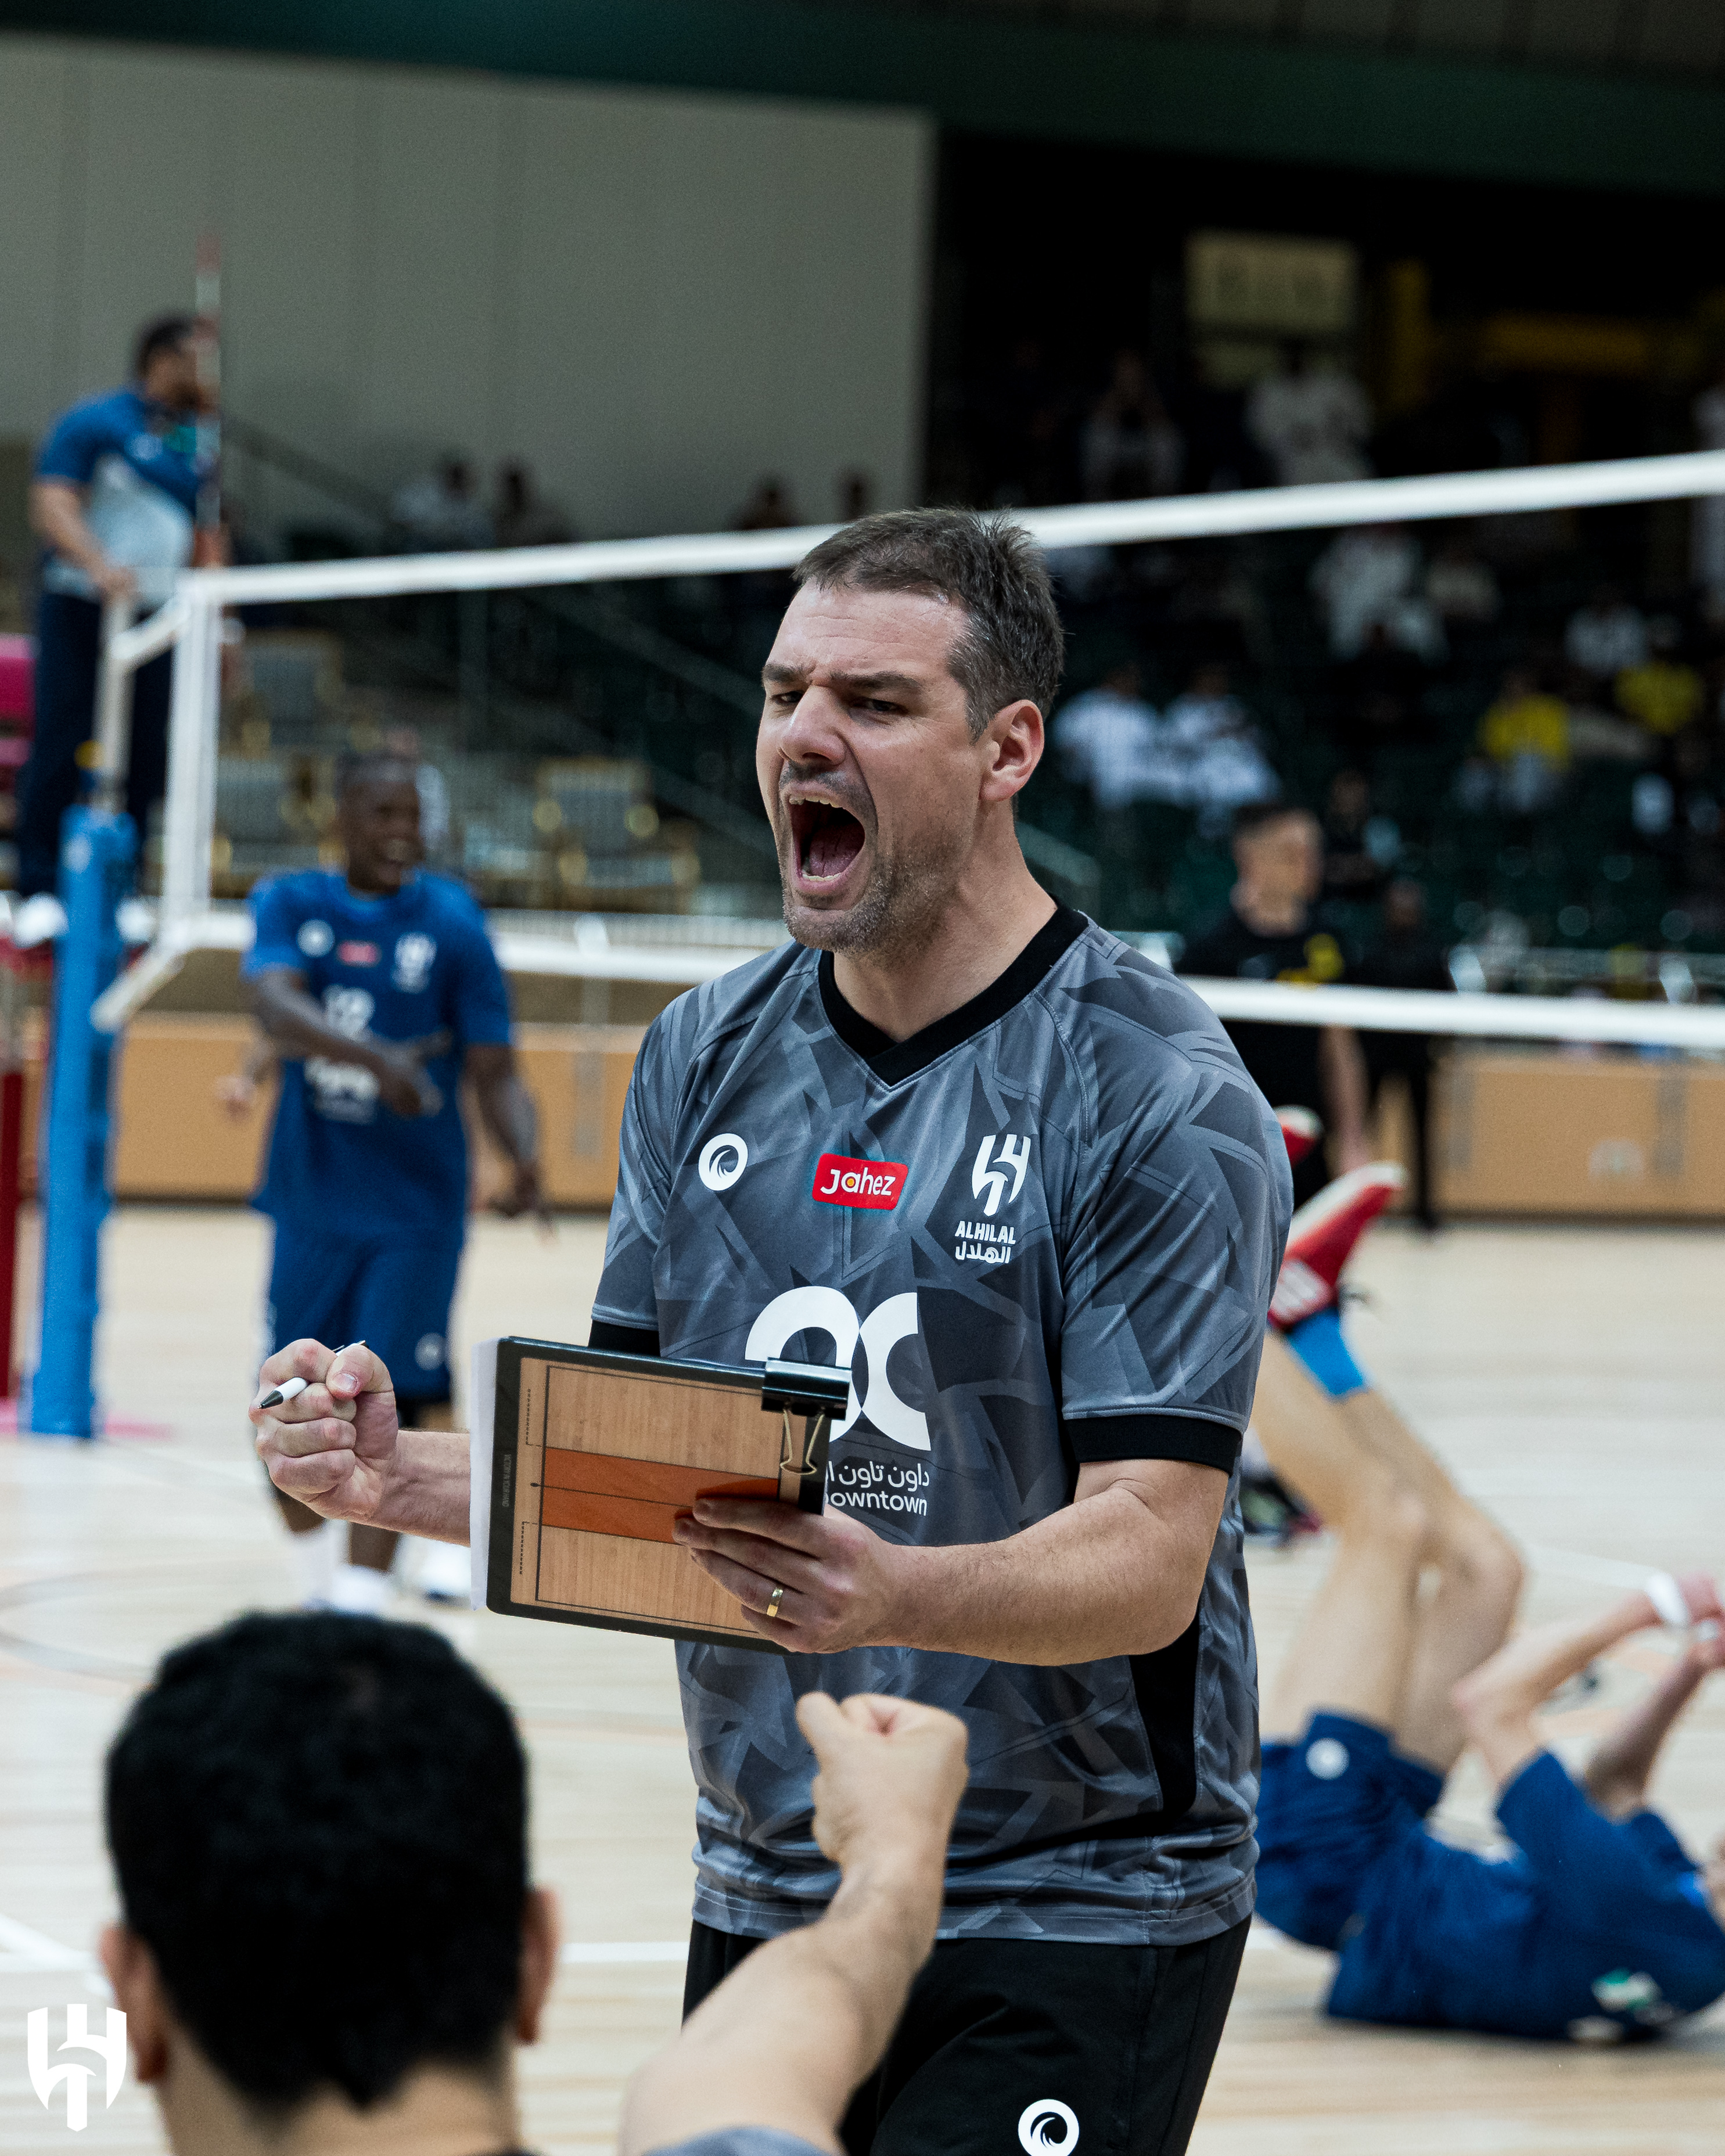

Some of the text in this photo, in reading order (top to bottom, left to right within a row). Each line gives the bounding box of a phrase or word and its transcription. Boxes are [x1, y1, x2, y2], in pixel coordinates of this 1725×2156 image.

[820, 1167, 896, 1196] Jahez
[954, 1220, 1016, 1245] ALHILAL
[955, 1241, 1011, 1264] الهلال
[838, 1461, 885, 1488] تاون
[888, 1463, 929, 1492] داون
[825, 1490, 928, 1517] owntown
